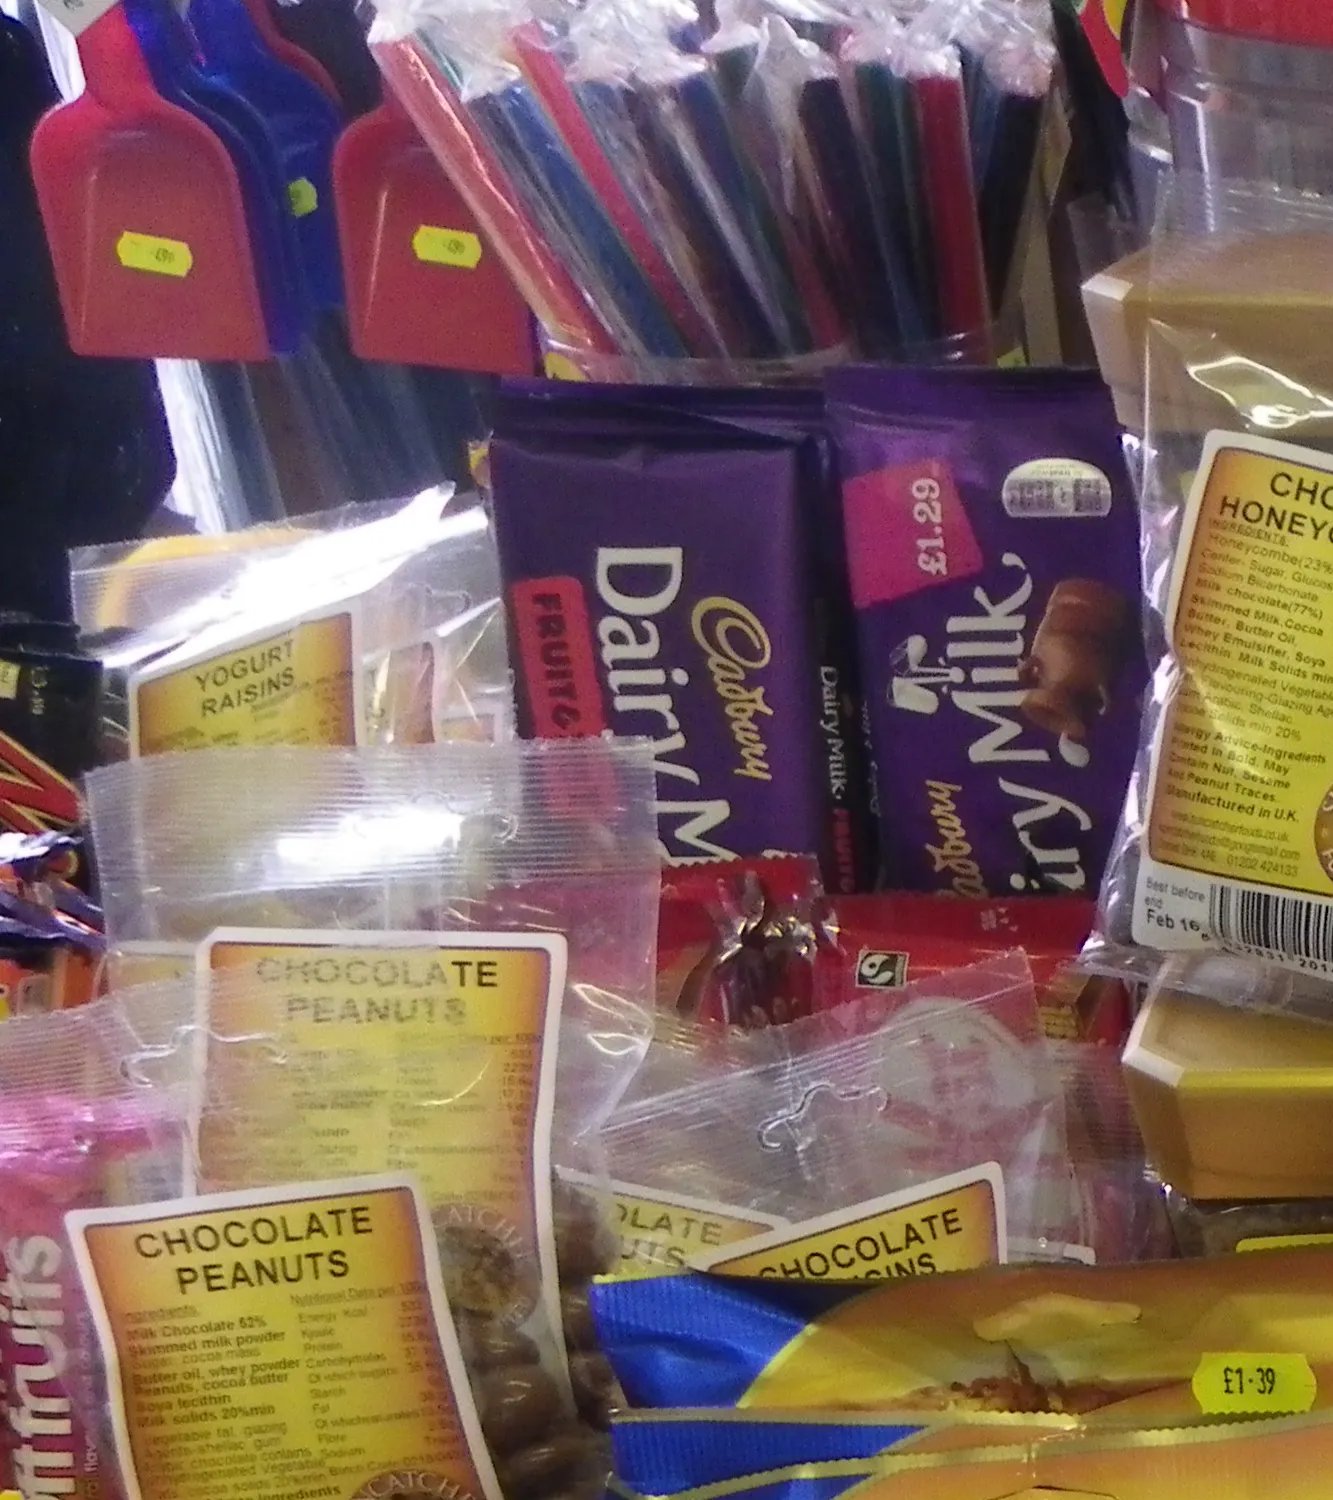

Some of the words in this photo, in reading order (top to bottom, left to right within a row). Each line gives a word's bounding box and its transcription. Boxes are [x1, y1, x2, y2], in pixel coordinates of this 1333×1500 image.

[196, 638, 298, 691] YOGURT
[530, 592, 582, 699] FRUIT
[596, 547, 700, 786] Dairy
[200, 668, 298, 718] RAISINS
[691, 596, 774, 782] Cadbury
[1146, 908, 1176, 930] Feb
[256, 955, 501, 988] CHOCOLATE
[284, 995, 468, 1027] PEANUTS
[134, 1205, 374, 1260] CHOCOLATE
[177, 1248, 351, 1297] PEANUTS
